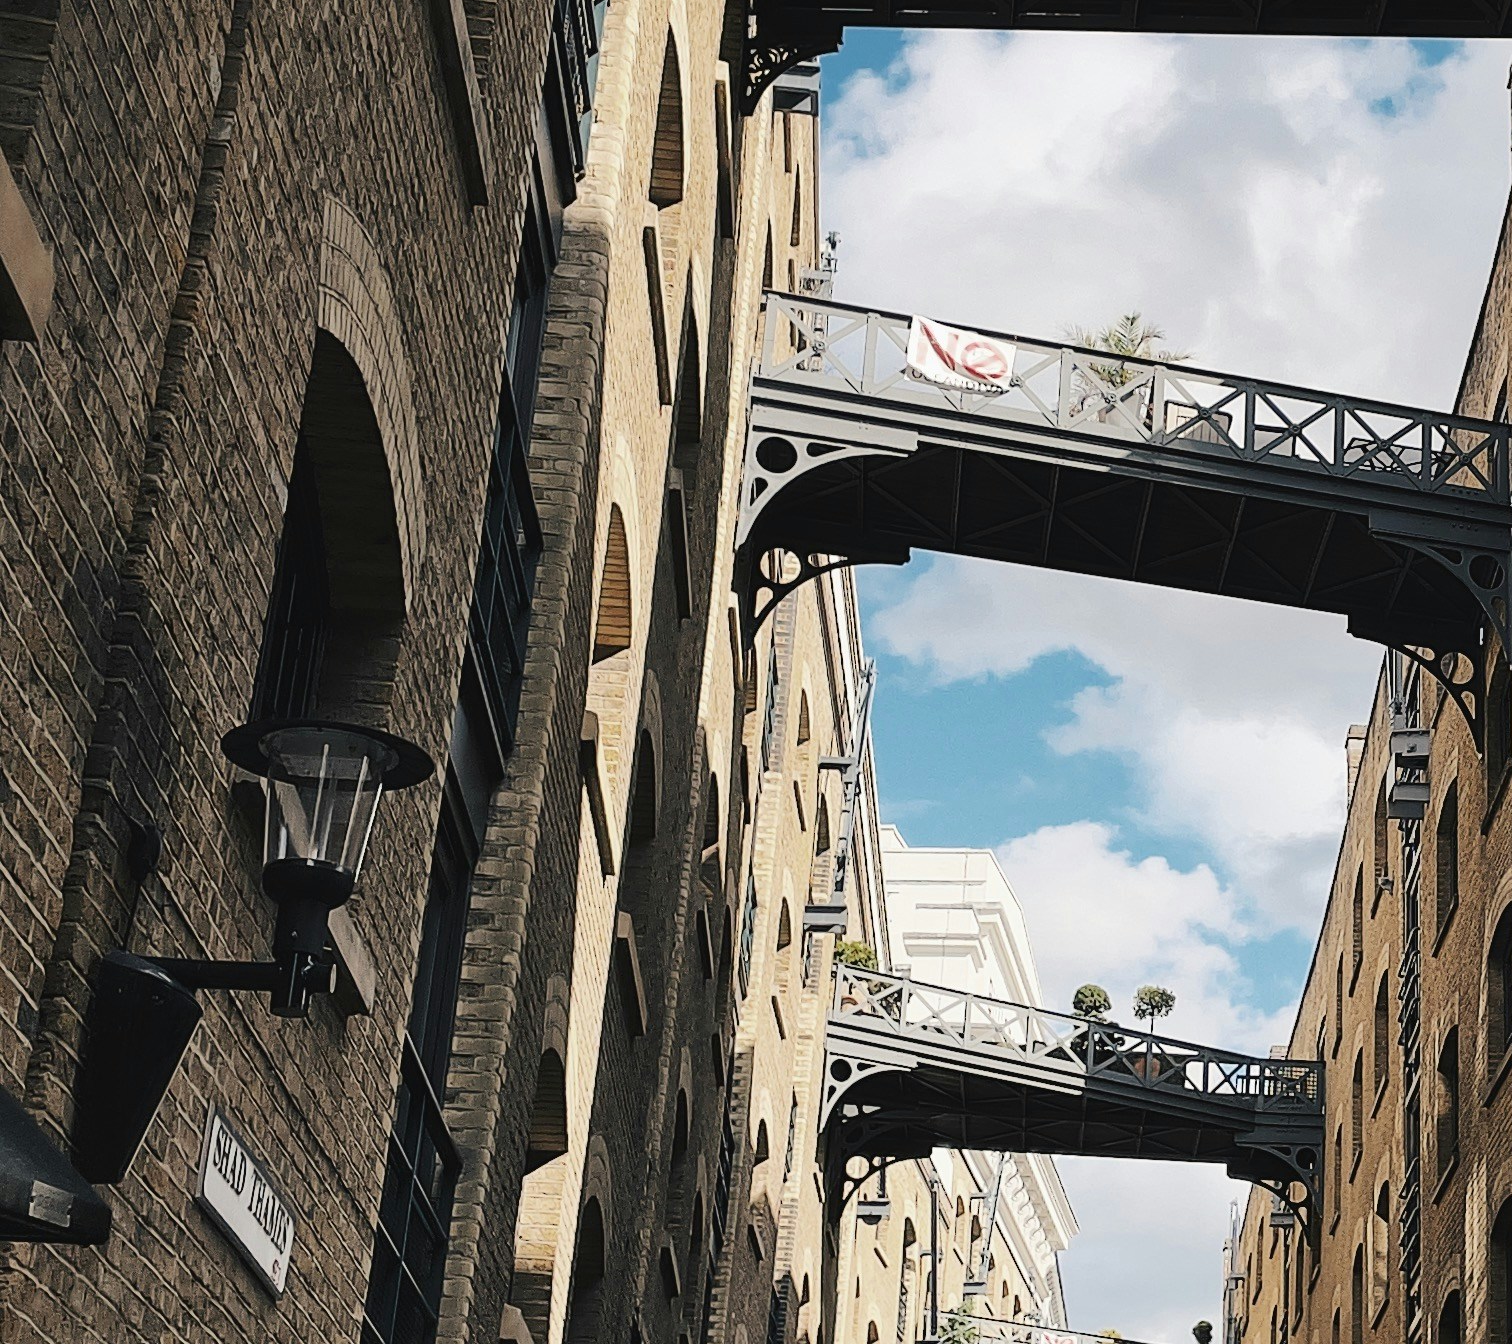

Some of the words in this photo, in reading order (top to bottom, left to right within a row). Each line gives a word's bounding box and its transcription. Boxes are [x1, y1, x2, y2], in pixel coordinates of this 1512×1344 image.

[915, 318, 1009, 380] NO
[213, 1124, 247, 1196] SHAD
[247, 1168, 290, 1255] THAMES
